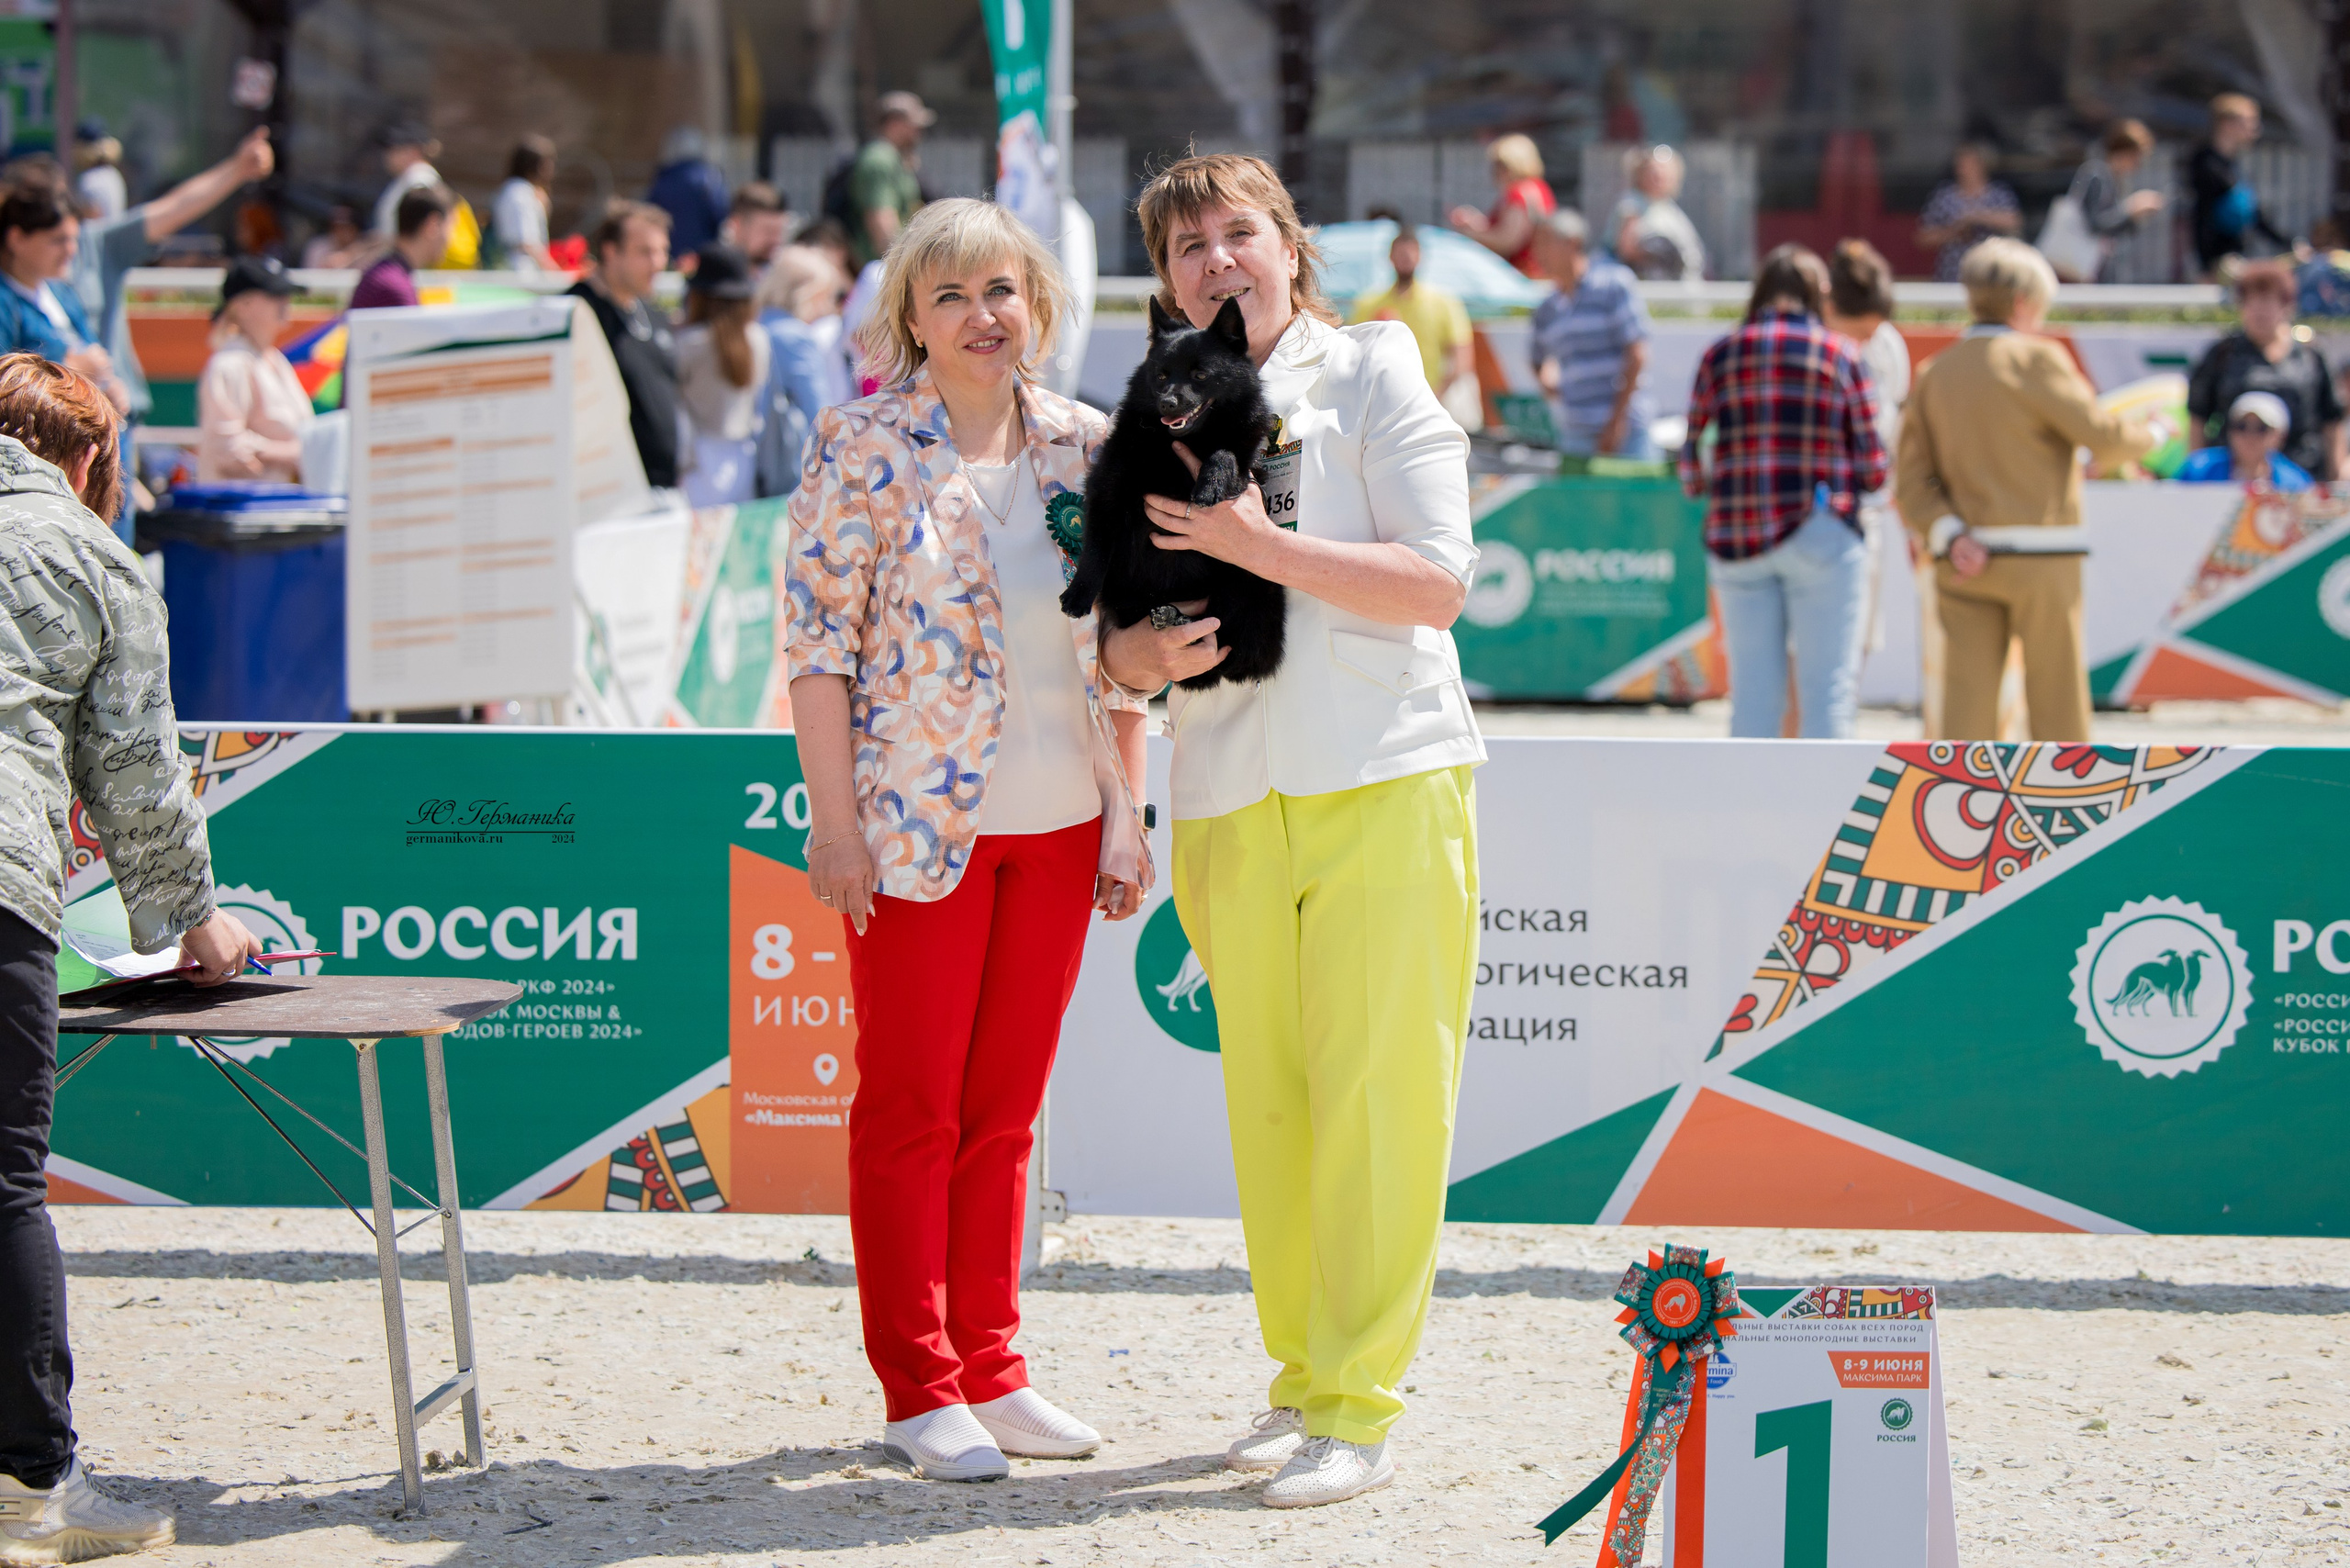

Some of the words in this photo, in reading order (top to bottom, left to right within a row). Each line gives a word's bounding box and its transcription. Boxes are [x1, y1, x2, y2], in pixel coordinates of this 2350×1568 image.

[341, 905, 638, 961] РОССИЯ
[750, 924, 795, 980] 8
[1475, 962, 1688, 989] огическая
[562, 980, 616, 995] 2024»
[517, 1004, 602, 1021] МОСКВЫ
[607, 1004, 622, 1021] &
[450, 1023, 584, 1041] ОДОВ-ГЕРОЕВ
[588, 1024, 643, 1039] 2024»
[2273, 1037, 2340, 1055] КУБОК
[743, 1091, 838, 1106] Московская
[744, 1108, 842, 1127] «Максима
[1767, 1323, 1820, 1331] ВЫСТАВКИ
[1889, 1324, 1924, 1333] ПОРОД
[1774, 1335, 1859, 1343] МОНОПОРОДНЫЕ
[1863, 1336, 1917, 1344] ВЫСТАВКИ
[1707, 1364, 1734, 1375] mina
[1843, 1359, 1869, 1372] 8-9
[1874, 1359, 1924, 1372] ИЮНЯ
[1842, 1373, 1895, 1383] МАКСИМА
[1897, 1373, 1922, 1383] ПАРК
[1876, 1434, 1918, 1443] РОССИЯ
[1754, 1398, 1833, 1568] 1
